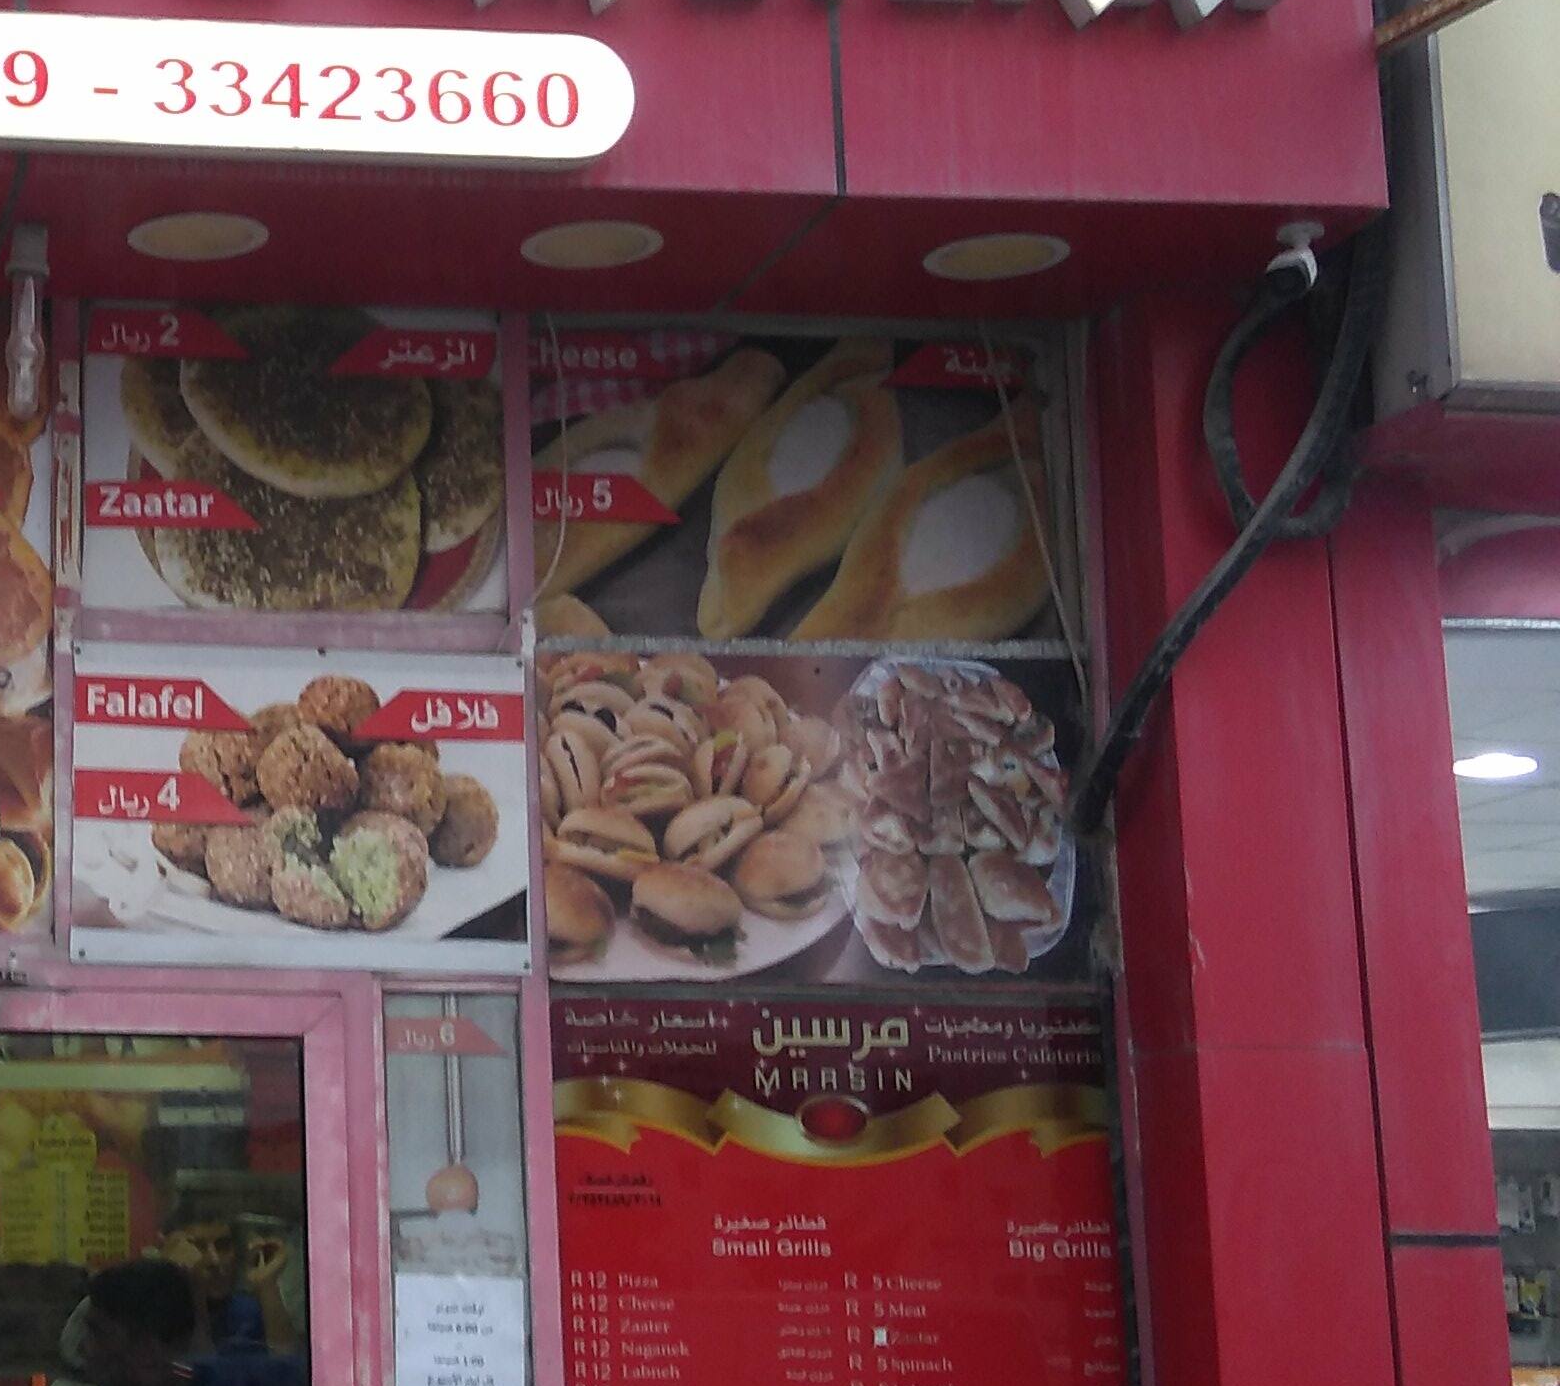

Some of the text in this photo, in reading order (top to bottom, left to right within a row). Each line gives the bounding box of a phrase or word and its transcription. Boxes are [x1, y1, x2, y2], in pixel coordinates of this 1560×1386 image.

[153, 56, 581, 130] 33423660
[100, 314, 180, 353] 2 ريال
[379, 338, 477, 372] الزعتر
[98, 485, 215, 519] Zaatar
[591, 477, 613, 510] 5
[86, 683, 204, 720] Falafel
[410, 697, 500, 734] فلافل
[96, 776, 181, 818] 4 ريال
[751, 1007, 910, 1062] مرسين
[711, 1238, 771, 1258] Small
[1008, 1239, 1047, 1263] Big
